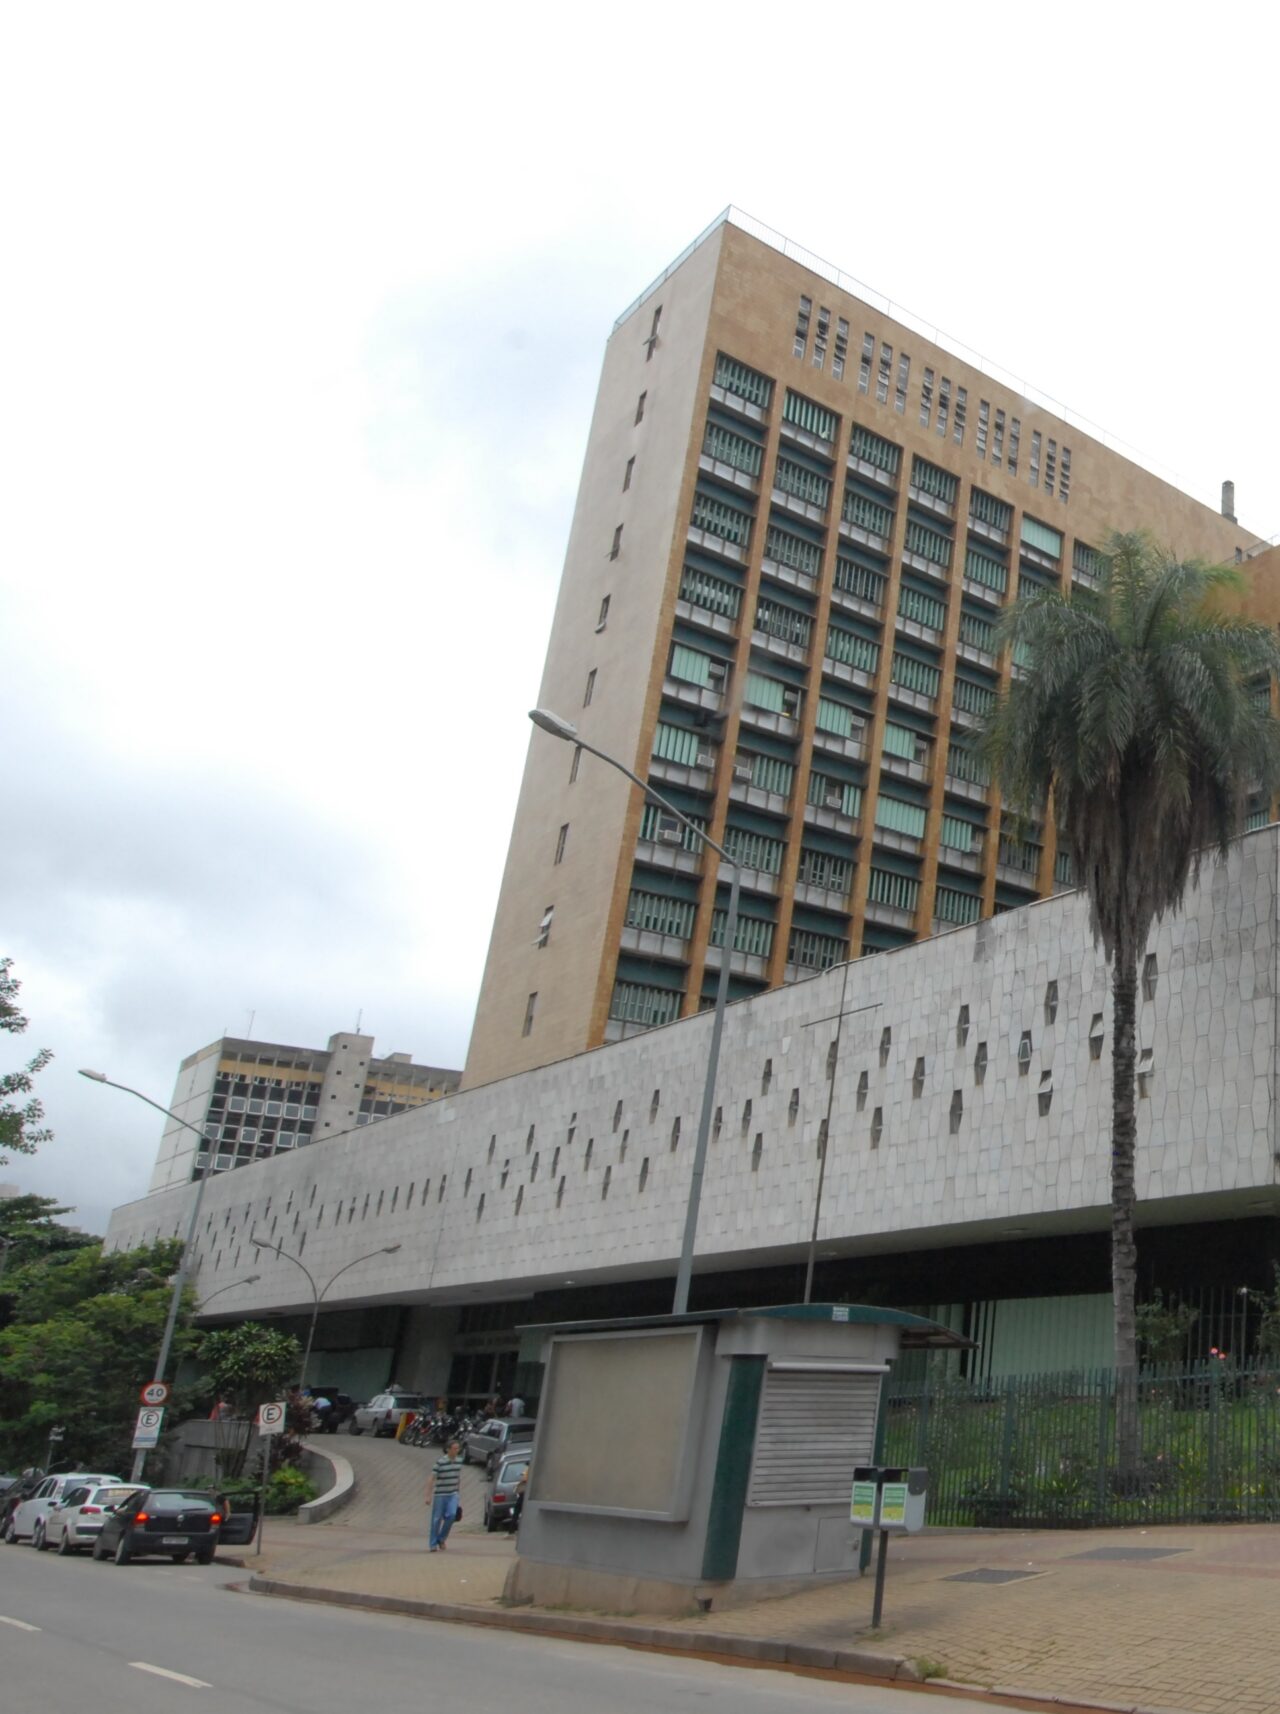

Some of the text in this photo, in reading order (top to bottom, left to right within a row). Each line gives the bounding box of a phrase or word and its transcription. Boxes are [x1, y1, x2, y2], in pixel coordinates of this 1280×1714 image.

[146, 1388, 164, 1397] 40
[145, 1414, 154, 1425] E
[266, 1407, 276, 1421] E
